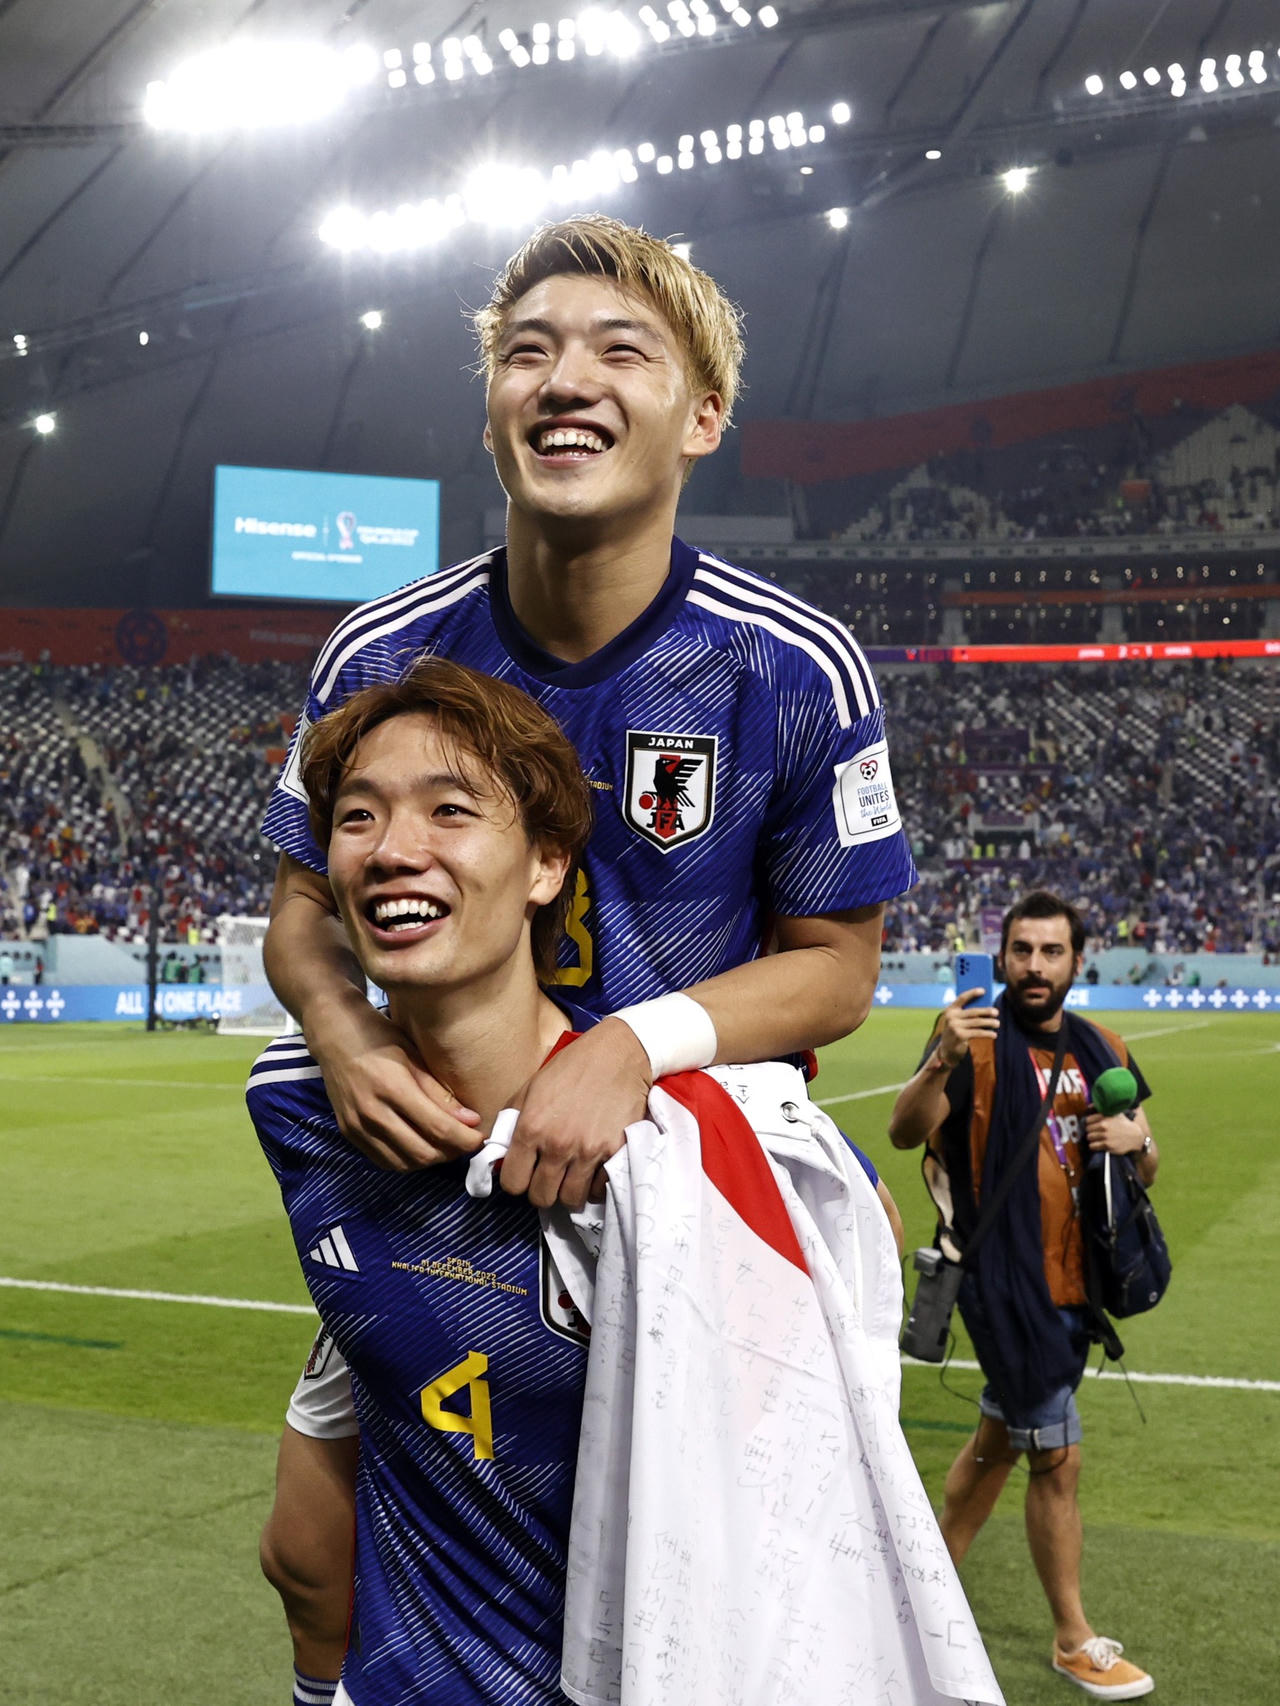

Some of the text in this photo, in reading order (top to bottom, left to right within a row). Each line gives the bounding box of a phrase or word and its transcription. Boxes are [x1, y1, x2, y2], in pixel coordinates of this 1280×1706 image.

[235, 516, 317, 538] Hisense
[648, 737, 694, 749] JAPAN
[588, 780, 613, 791] TADIUM
[857, 783, 887, 796] FOOTBALL
[859, 790, 889, 807] UNITES
[646, 812, 685, 831] JFA
[115, 991, 144, 1015] ALL
[164, 991, 195, 1013] ONE
[197, 990, 242, 1012] PLACE
[432, 1260, 473, 1276] DECEMBER
[476, 1270, 497, 1281] 2022
[447, 1257, 471, 1267] SPAIN
[491, 1281, 528, 1296] STADIUM
[420, 1350, 495, 1460] 4
